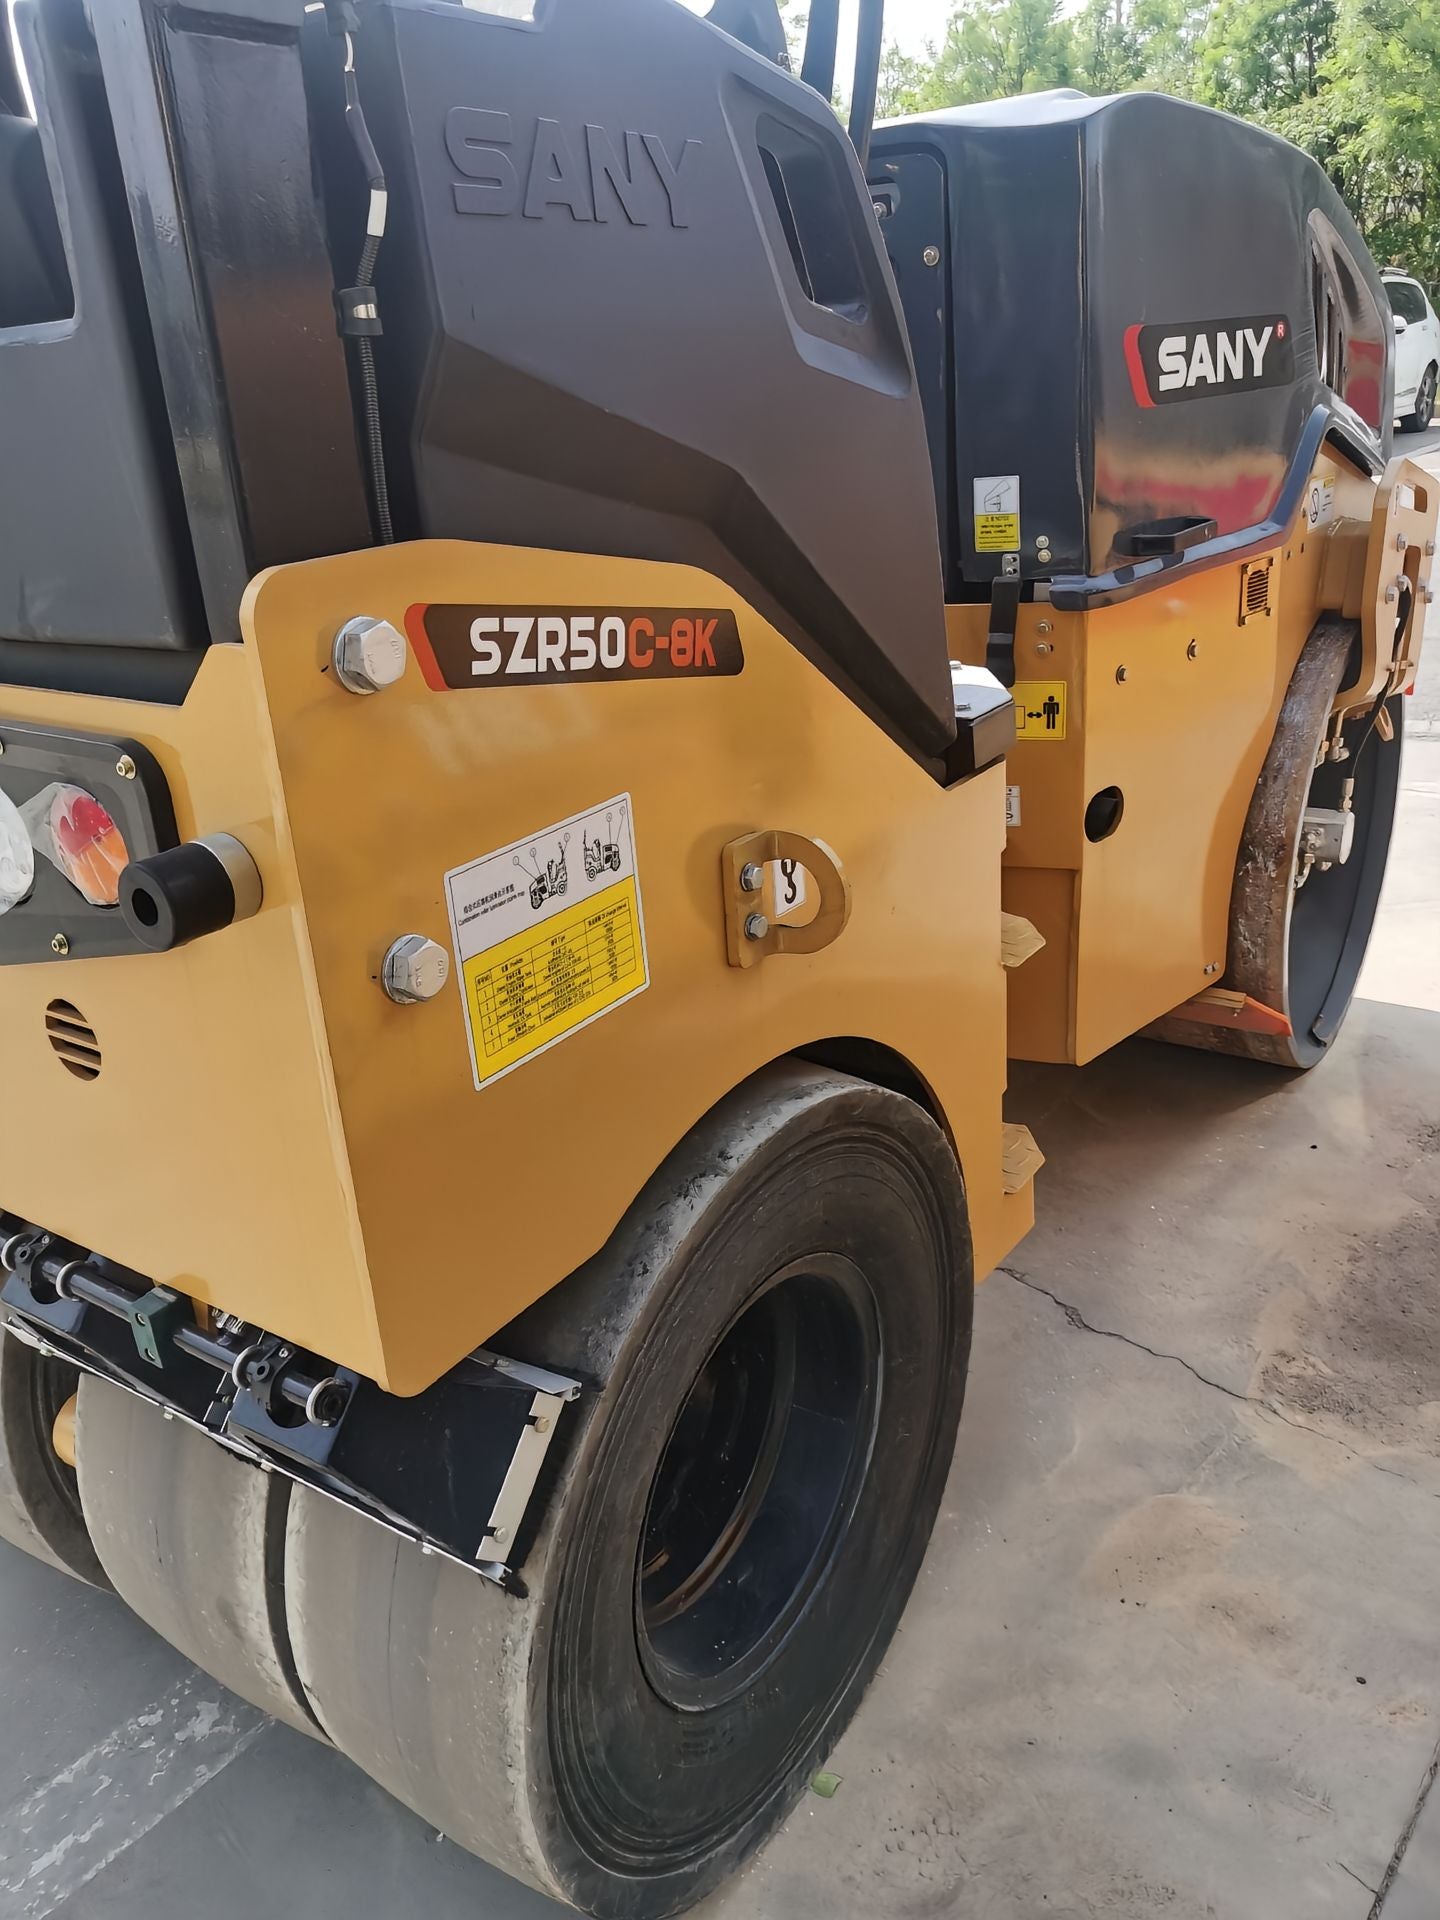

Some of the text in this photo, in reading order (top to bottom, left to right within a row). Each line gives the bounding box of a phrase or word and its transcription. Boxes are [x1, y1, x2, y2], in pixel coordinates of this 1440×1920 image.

[444, 106, 703, 228] SANY
[1158, 326, 1274, 392] SANY
[469, 616, 719, 676] SZR50C-8K
